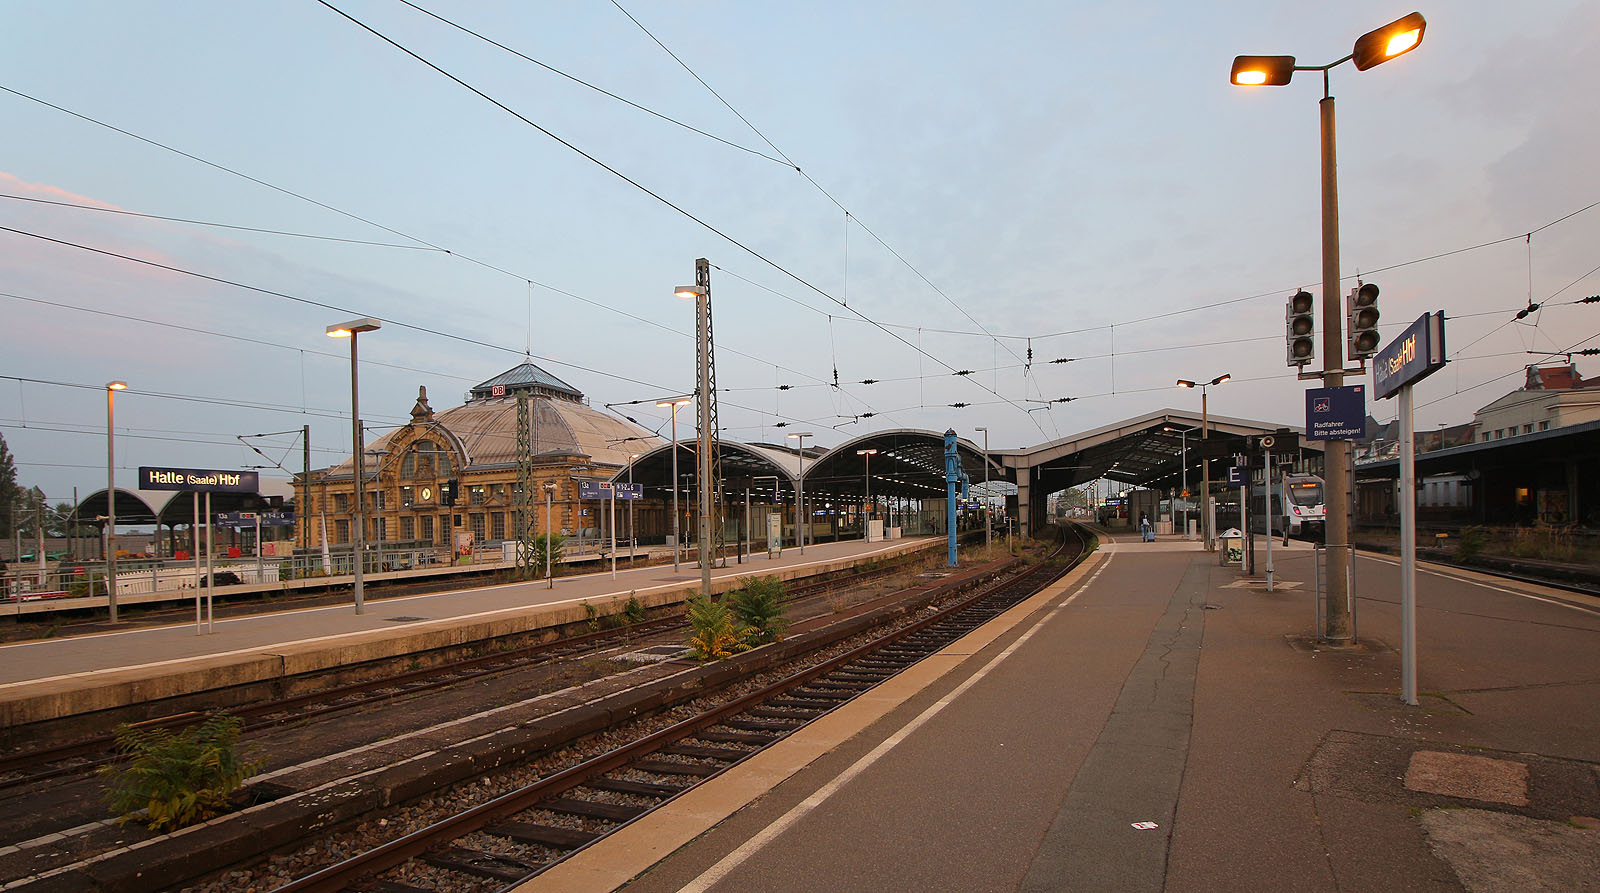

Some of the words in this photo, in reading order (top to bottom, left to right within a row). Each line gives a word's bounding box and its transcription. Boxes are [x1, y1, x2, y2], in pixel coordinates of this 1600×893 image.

[1402, 333, 1417, 366] Hbf
[494, 386, 503, 394] DB
[149, 471, 184, 484] Halle
[187, 474, 218, 485] (Saale)
[219, 473, 240, 486] Hbf
[1230, 466, 1241, 482] E
[775, 491, 781, 501] E
